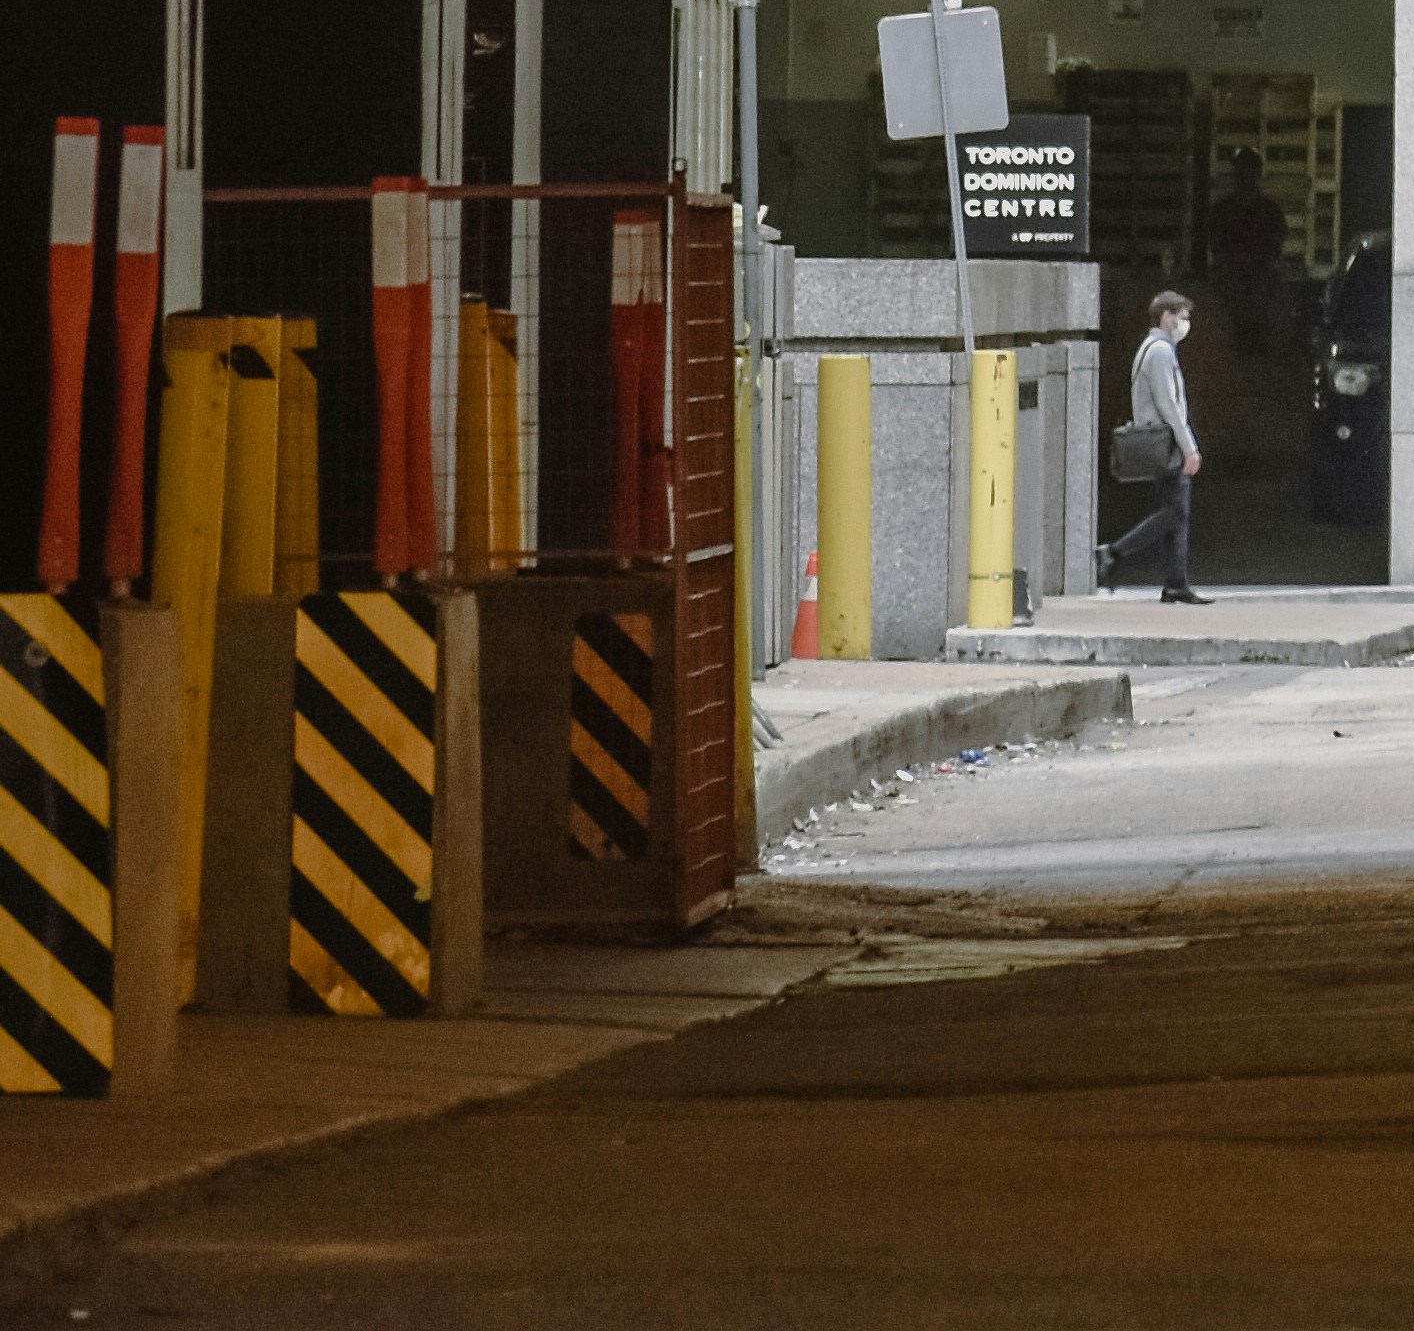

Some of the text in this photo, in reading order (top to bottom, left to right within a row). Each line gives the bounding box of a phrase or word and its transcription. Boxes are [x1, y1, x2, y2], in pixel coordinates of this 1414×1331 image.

[964, 146, 1075, 165] TORONTO
[963, 172, 1075, 191] DOMINION
[964, 199, 1074, 218] CENTRE
